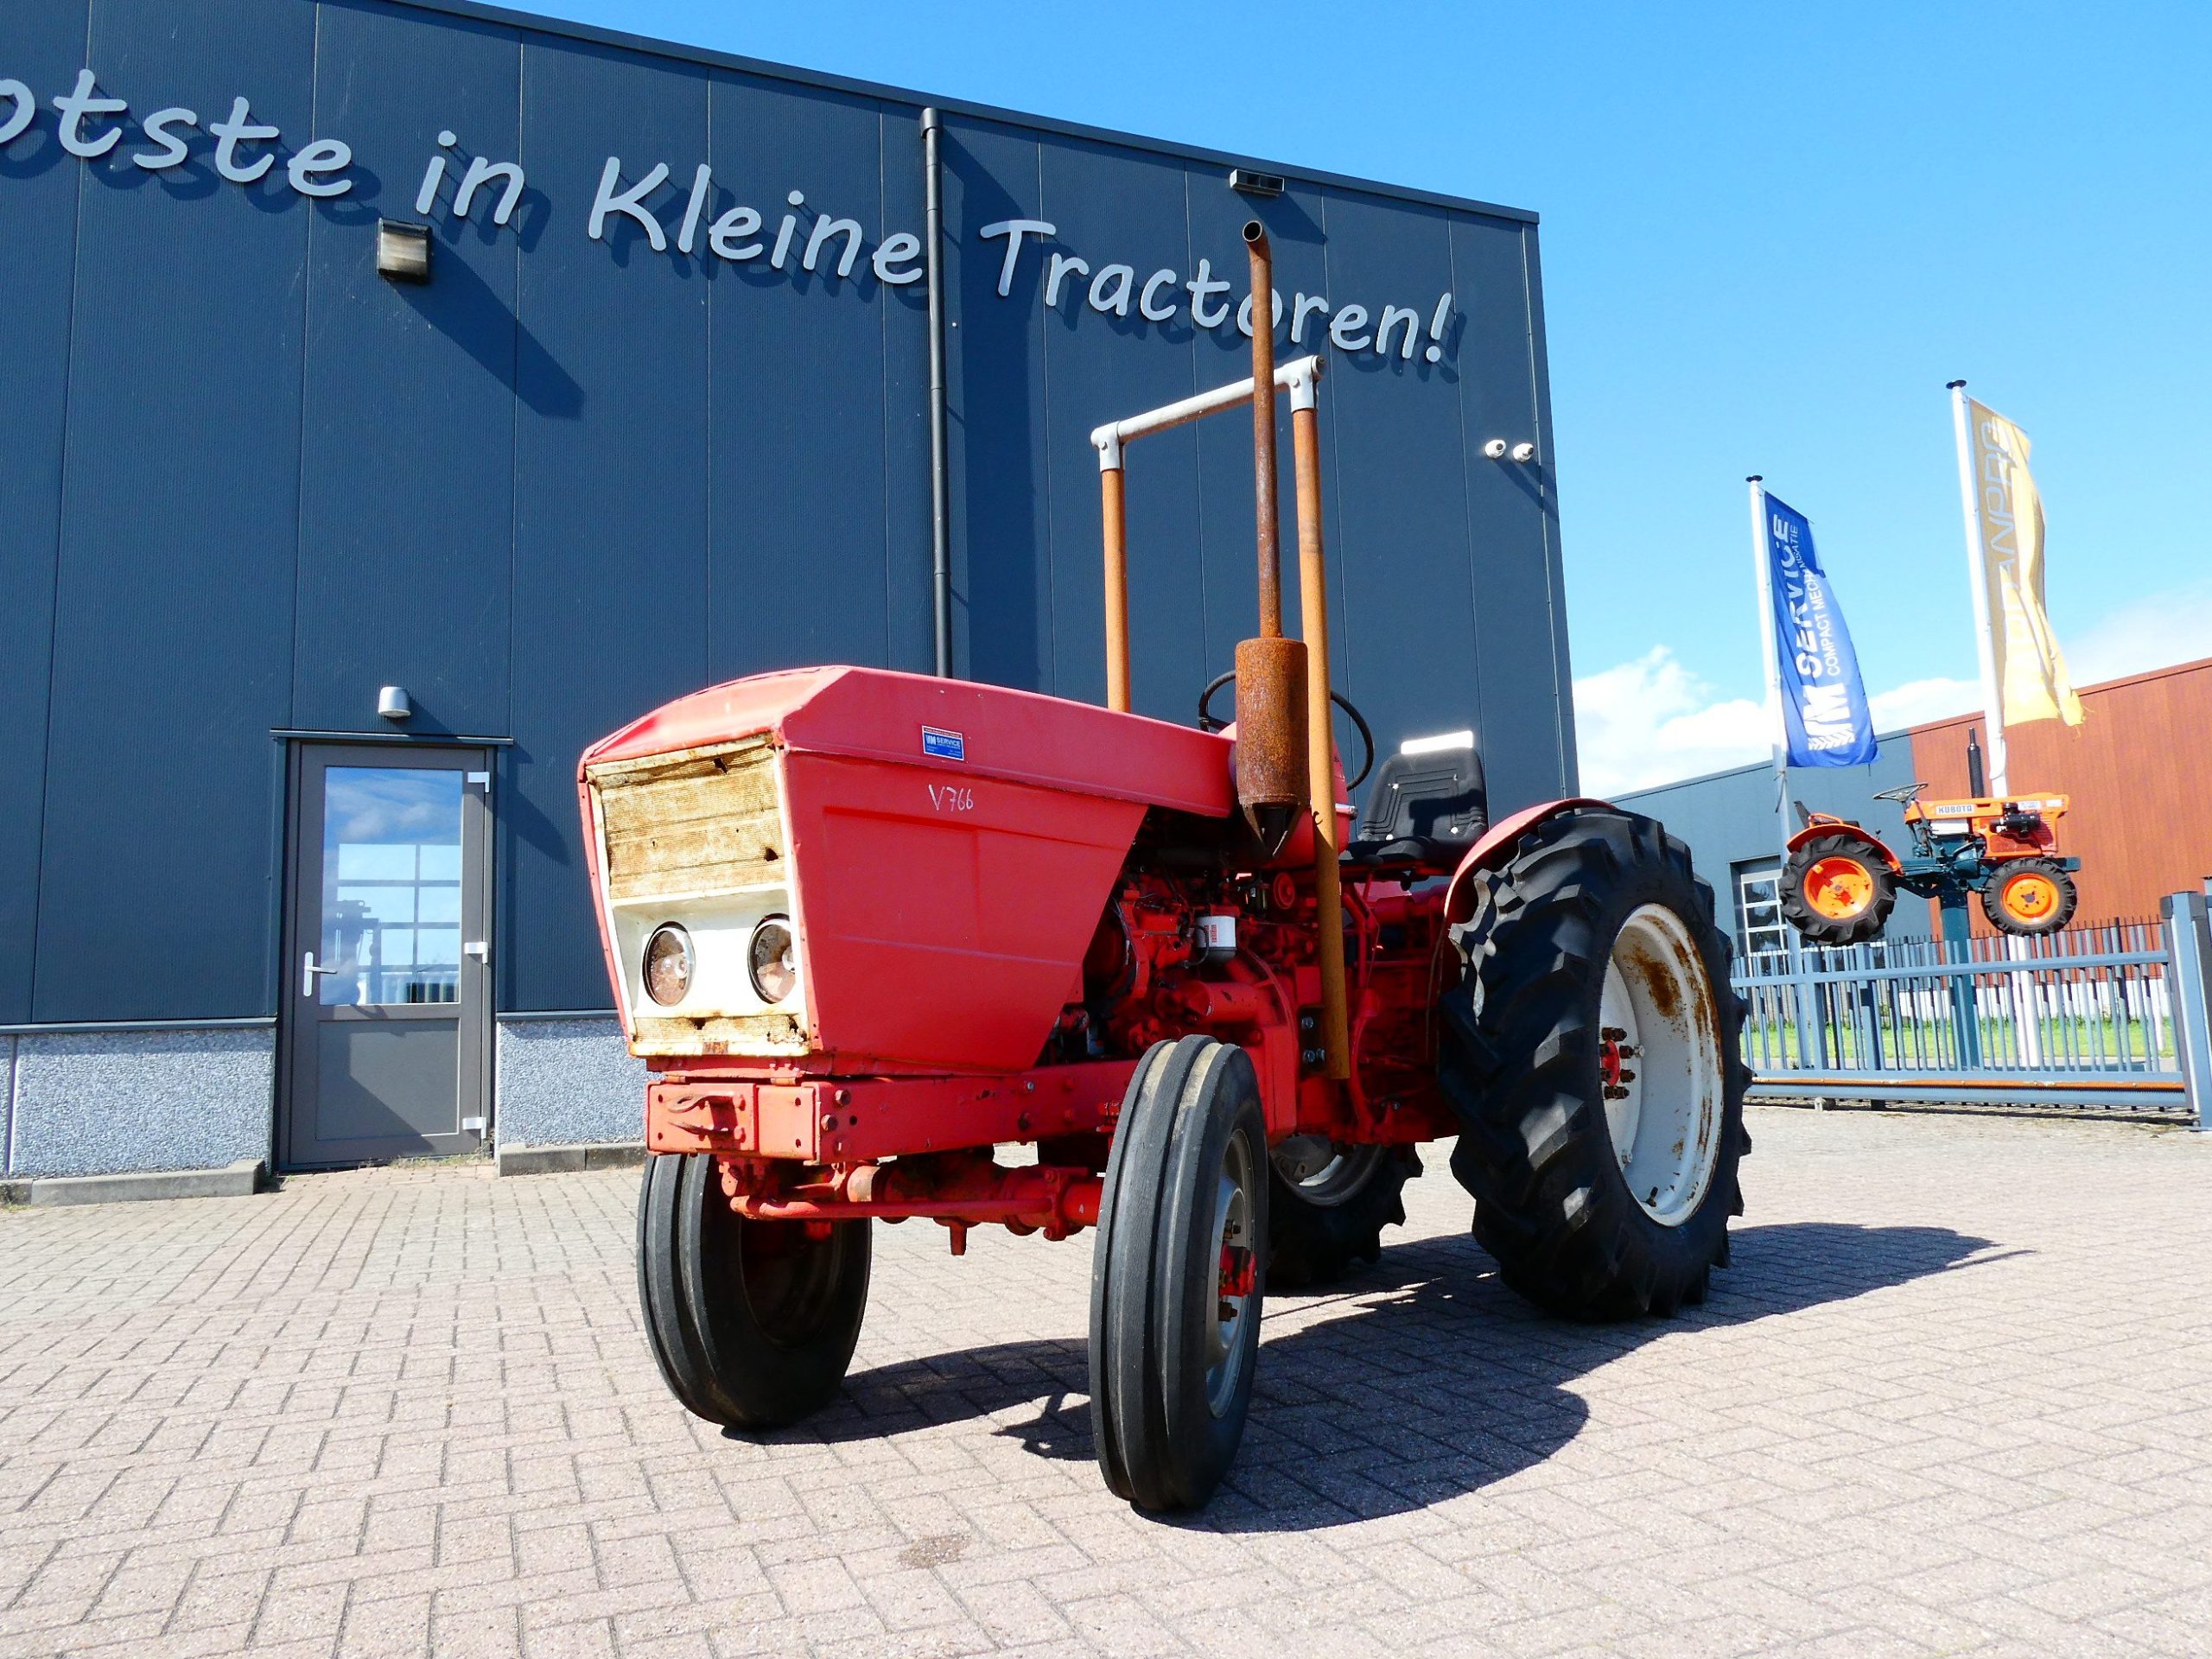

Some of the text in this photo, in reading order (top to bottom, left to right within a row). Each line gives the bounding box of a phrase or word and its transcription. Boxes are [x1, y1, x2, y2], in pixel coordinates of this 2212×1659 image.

[416, 130, 524, 225] in
[588, 156, 924, 285] Kleine
[980, 219, 1452, 363] Tractoren!
[1772, 513, 1823, 679] SERVICE
[1818, 613, 1840, 677] COMPACT
[1938, 805, 1973, 814] KUBOTA
